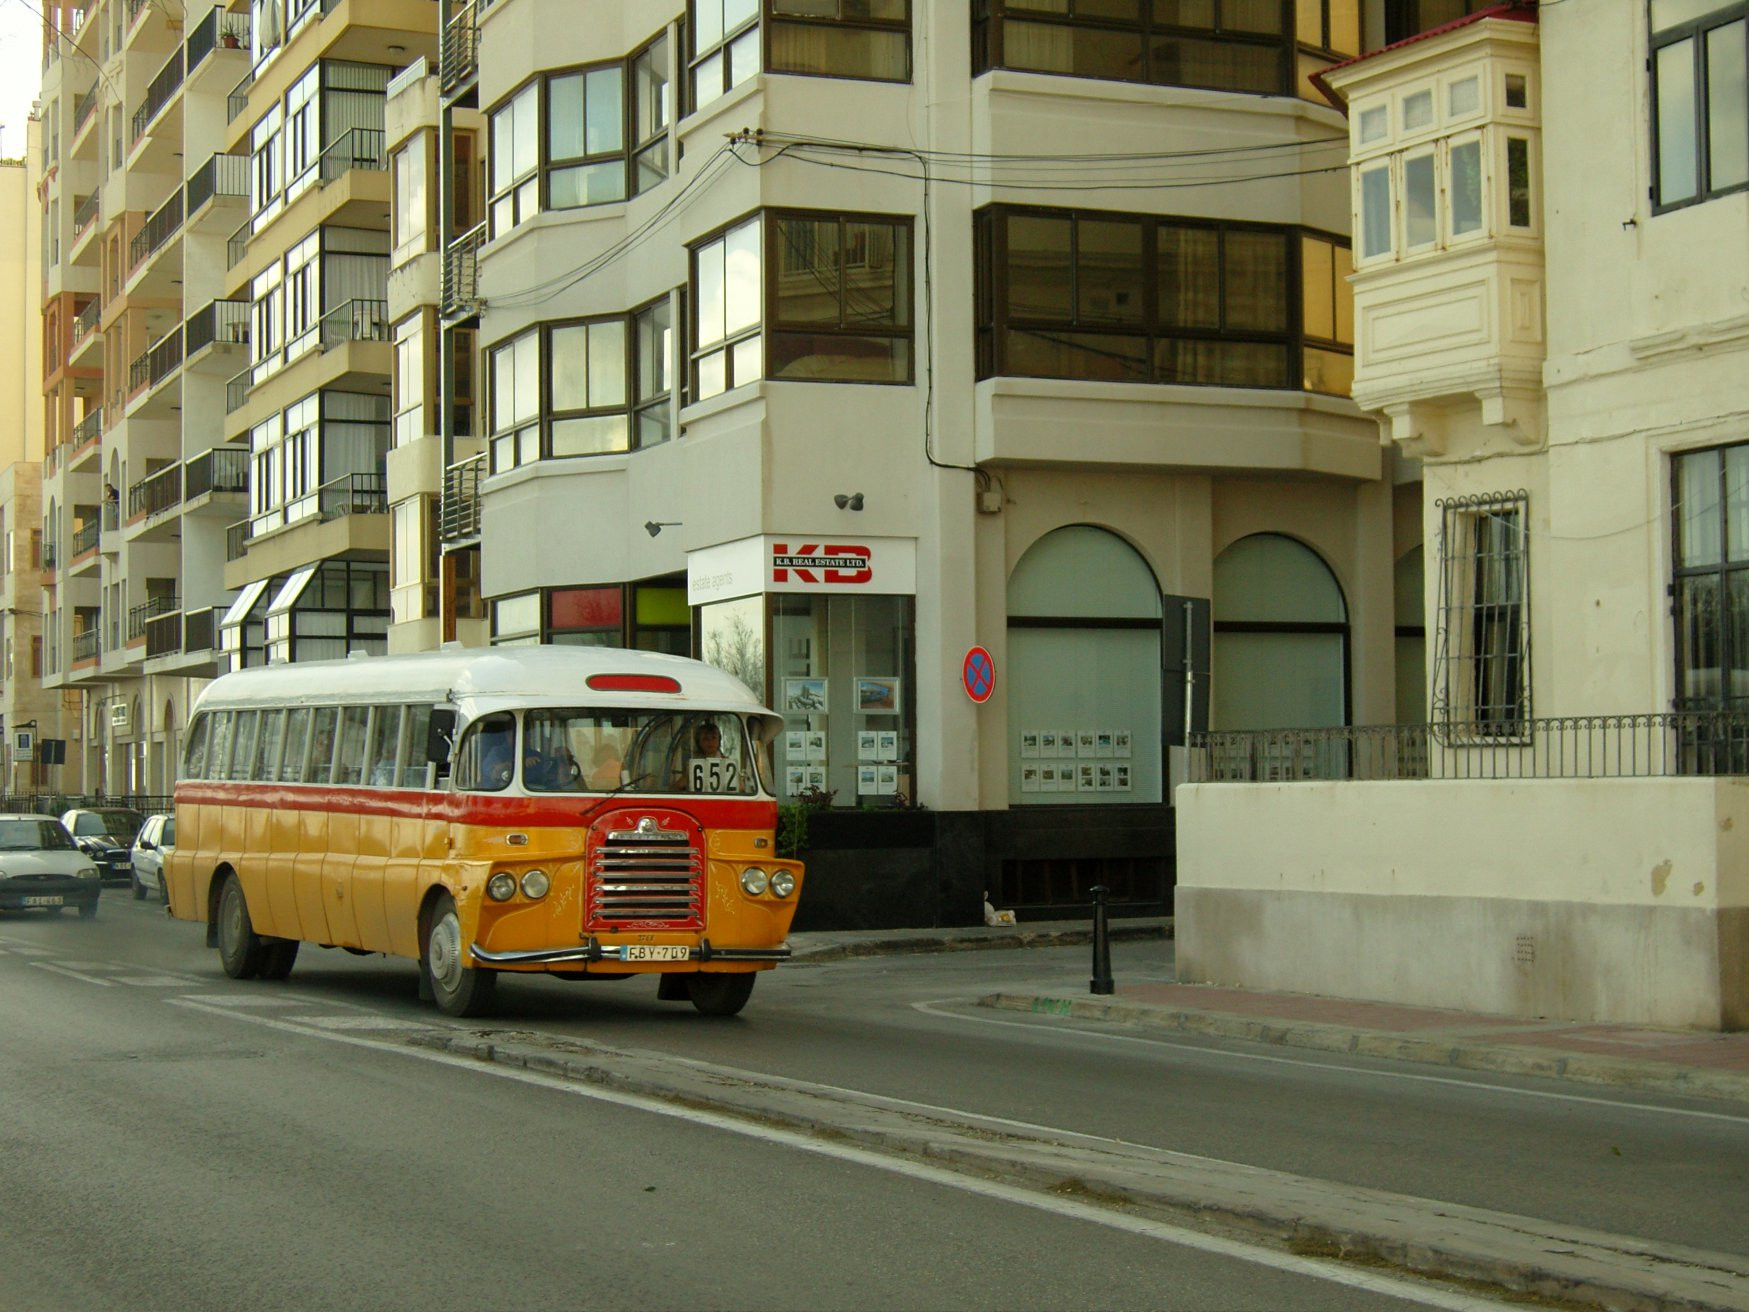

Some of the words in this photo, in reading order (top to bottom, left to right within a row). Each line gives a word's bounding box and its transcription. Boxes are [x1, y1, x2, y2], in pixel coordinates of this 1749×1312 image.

[775, 557, 791, 566] K.B.
[792, 558, 815, 566] REAL
[815, 558, 845, 567] ESTATE
[846, 559, 864, 567] LTD.
[693, 762, 737, 792] 652
